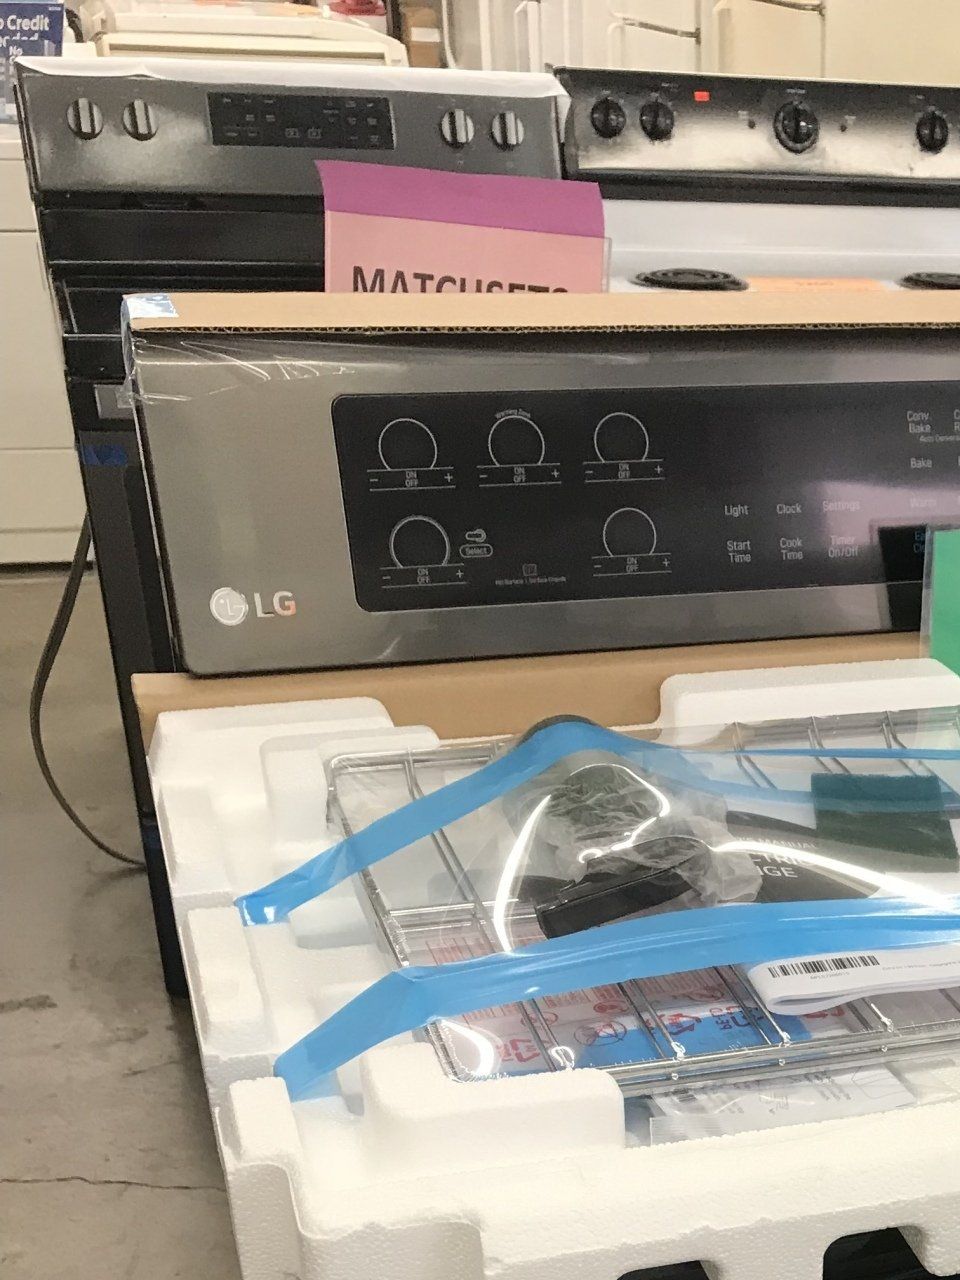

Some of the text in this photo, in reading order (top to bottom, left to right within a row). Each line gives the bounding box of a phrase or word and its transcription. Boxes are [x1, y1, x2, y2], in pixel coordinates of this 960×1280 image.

[7, 14, 50, 31] Credit
[907, 411, 930, 421] Conv
[908, 423, 931, 434] Bake
[910, 457, 933, 469] Bake
[724, 505, 749, 518] Light
[776, 503, 802, 515] Clock
[726, 540, 751, 551] Start
[780, 538, 803, 549] Cook
[728, 552, 751, 563] Time
[781, 550, 804, 561] Time
[253, 590, 297, 618] LG
